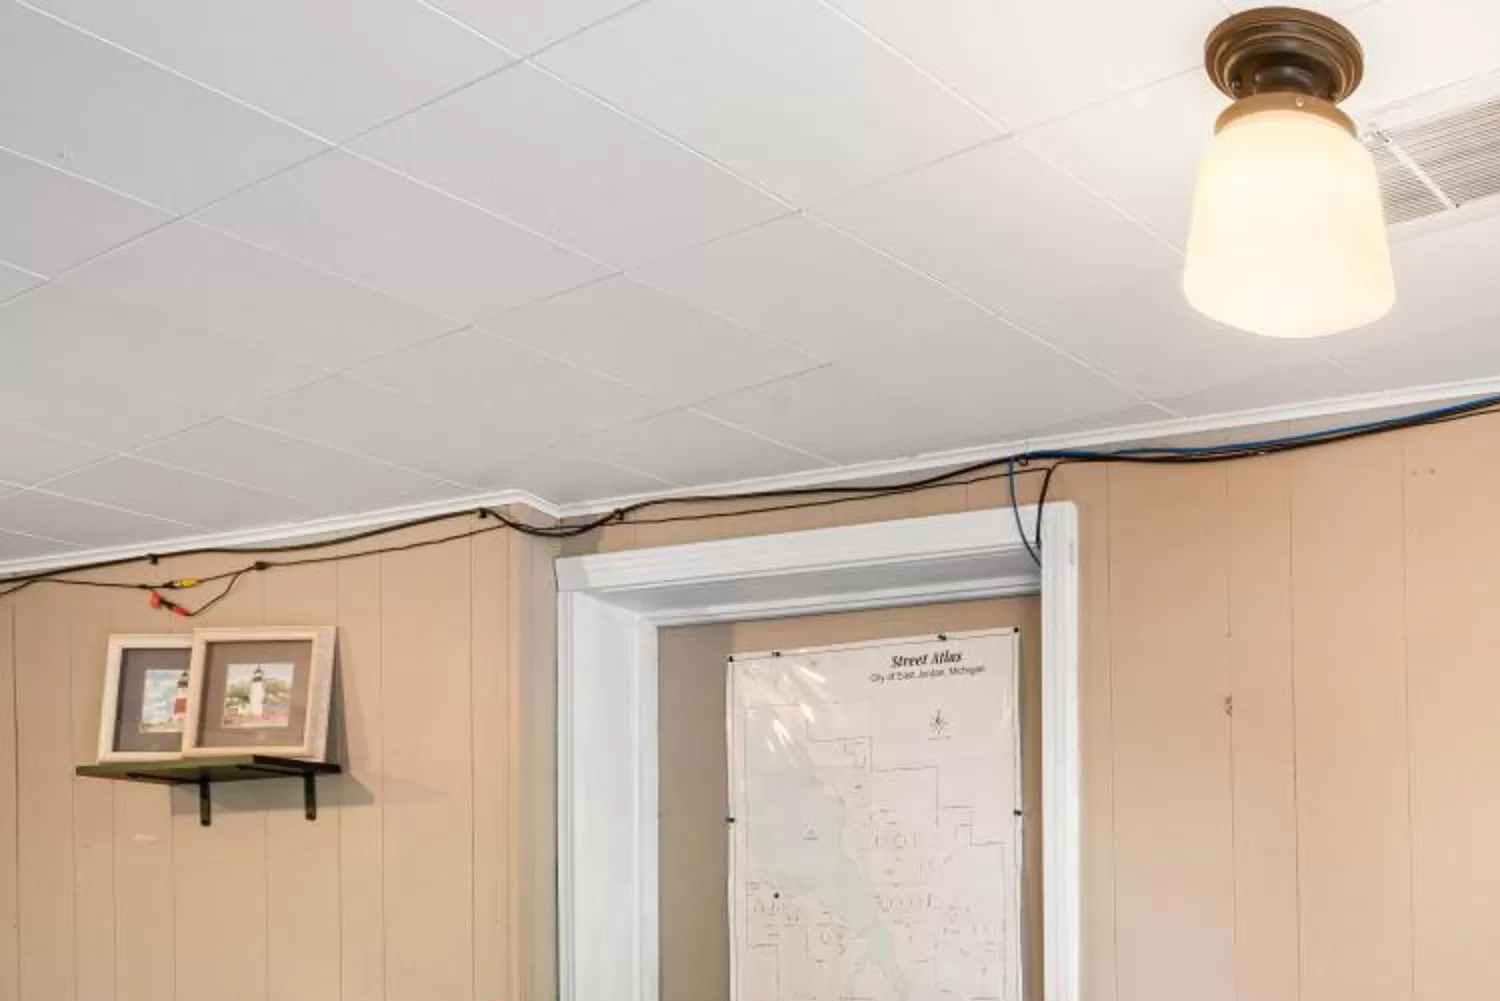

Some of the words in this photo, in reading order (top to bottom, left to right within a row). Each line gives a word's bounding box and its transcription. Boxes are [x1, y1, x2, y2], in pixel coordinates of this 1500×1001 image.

[890, 654, 928, 668] Street
[930, 649, 963, 665] Atlas
[869, 673, 885, 684] City
[897, 671, 915, 681] East
[948, 665, 986, 678] Michigan
